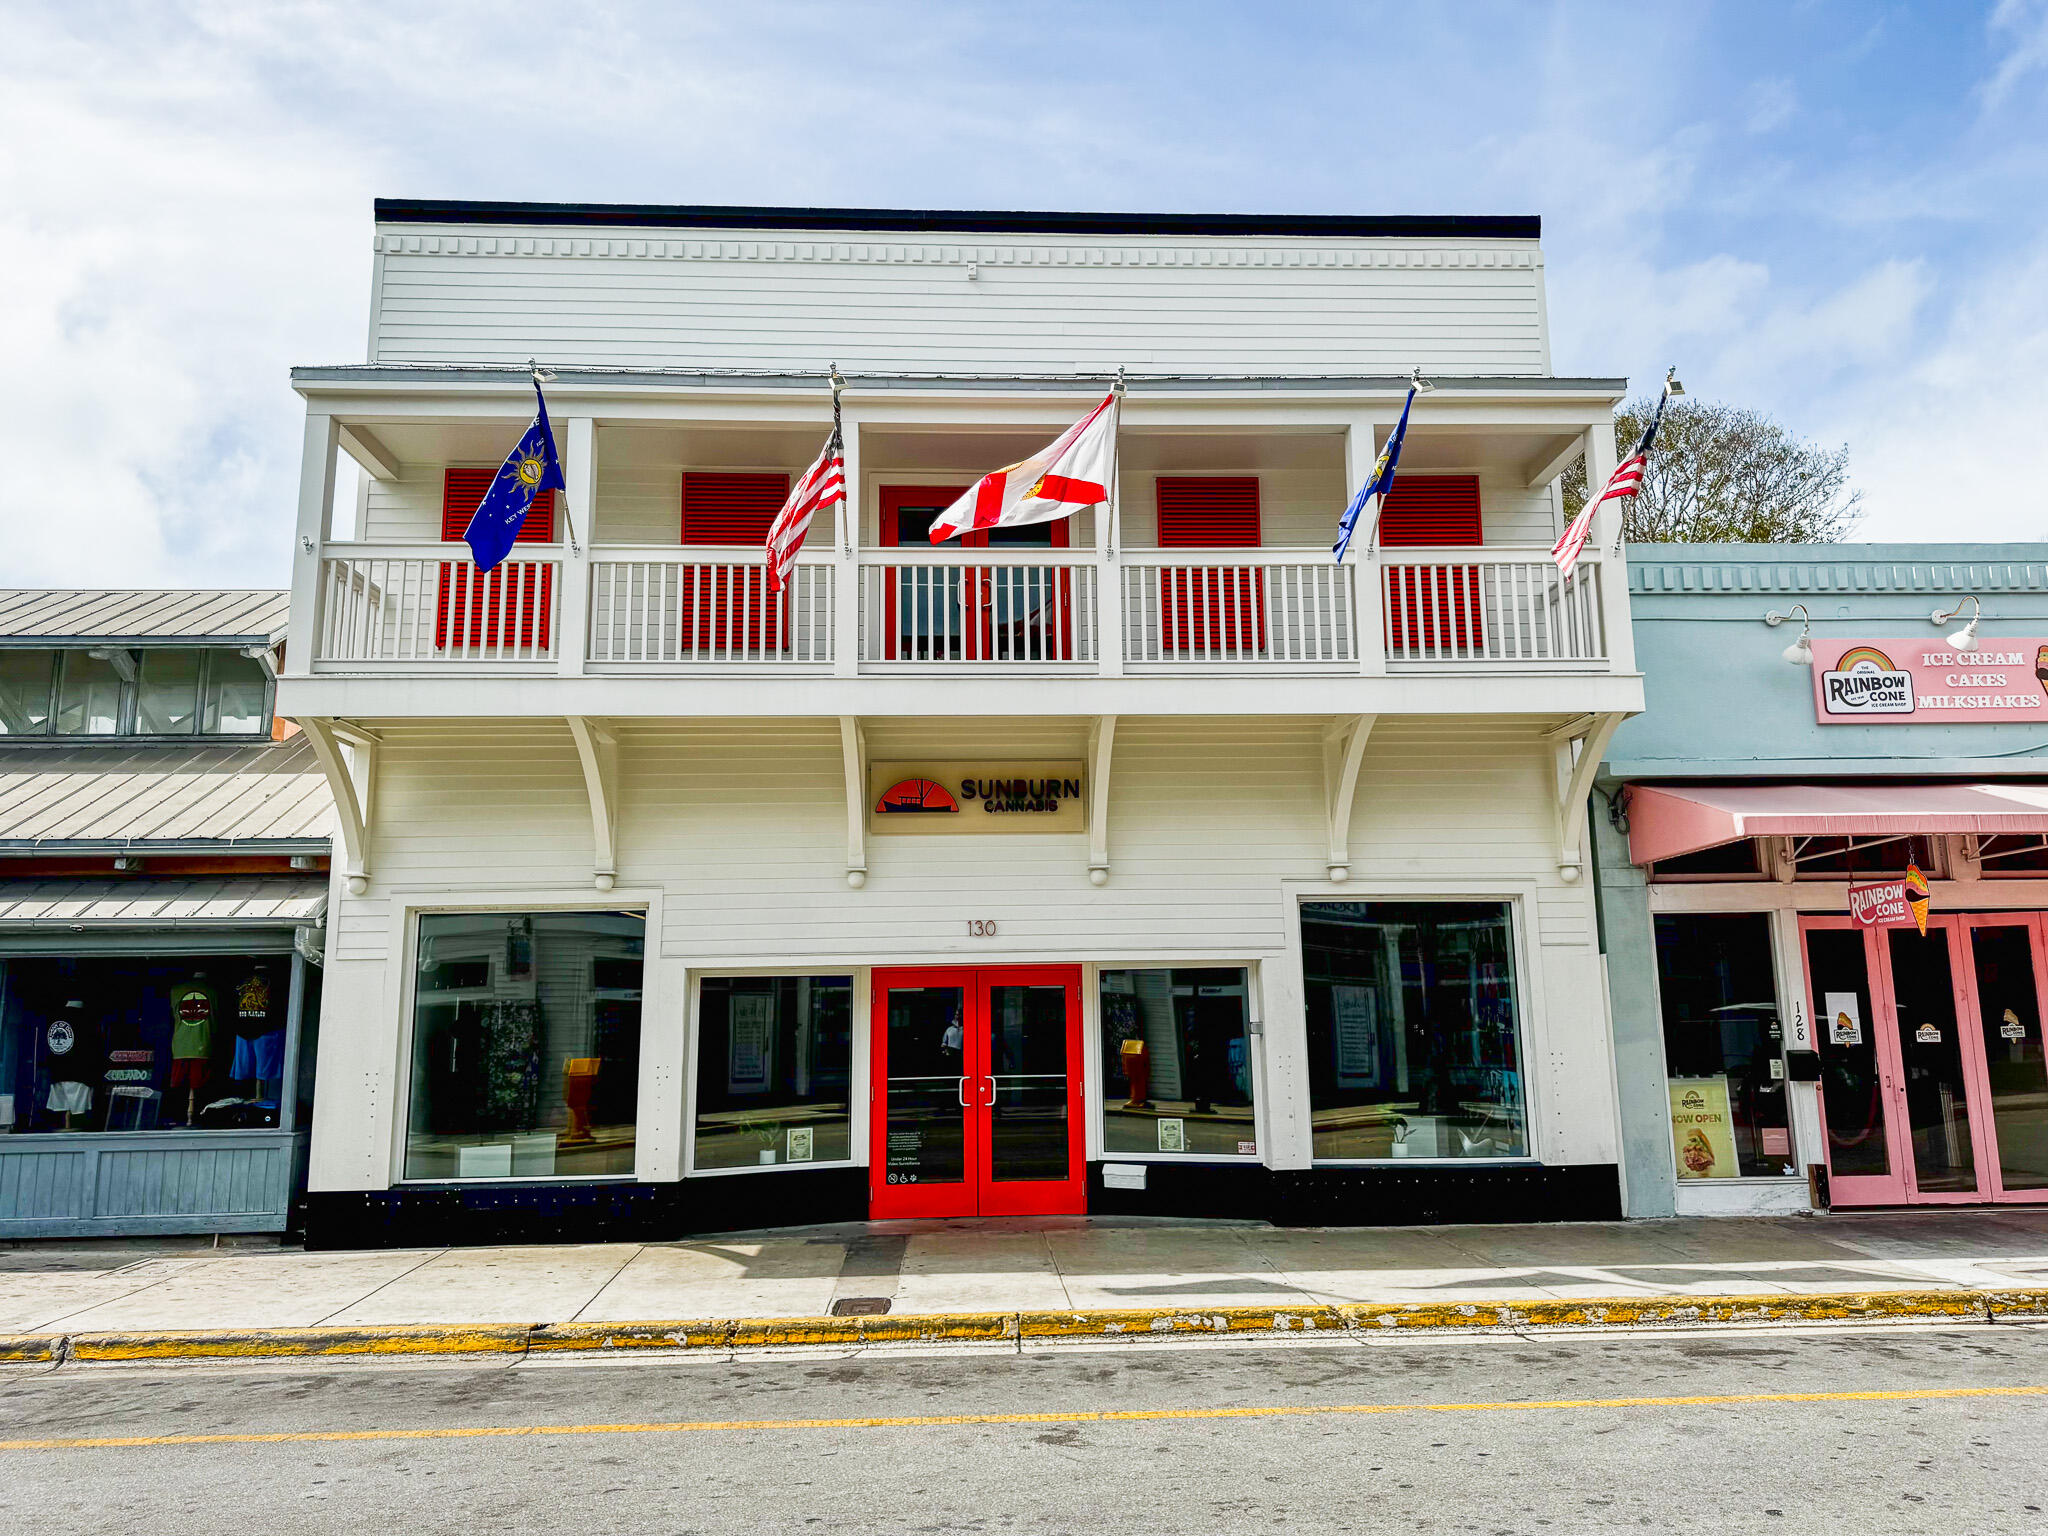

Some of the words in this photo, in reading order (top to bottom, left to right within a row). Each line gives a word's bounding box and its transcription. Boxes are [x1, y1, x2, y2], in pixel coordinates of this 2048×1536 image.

[504, 513, 518, 525] KEY
[517, 501, 533, 515] WES
[1922, 652, 1955, 667] ICE
[1956, 652, 2025, 667] CREAM
[1945, 673, 2008, 687] CAKES
[1829, 676, 1905, 707] RAINBOW
[1869, 691, 1906, 702] CONE
[1917, 694, 2041, 709] MILKSHAKES
[961, 779, 1080, 799] SUNBURN
[984, 800, 1058, 813] CANNABIS
[1850, 884, 1903, 924] RAINBOW
[1876, 902, 1905, 916] CONE
[967, 920, 997, 937] 130
[1795, 1001, 1805, 1041] 128
[1695, 1113, 1722, 1123] OPEN
